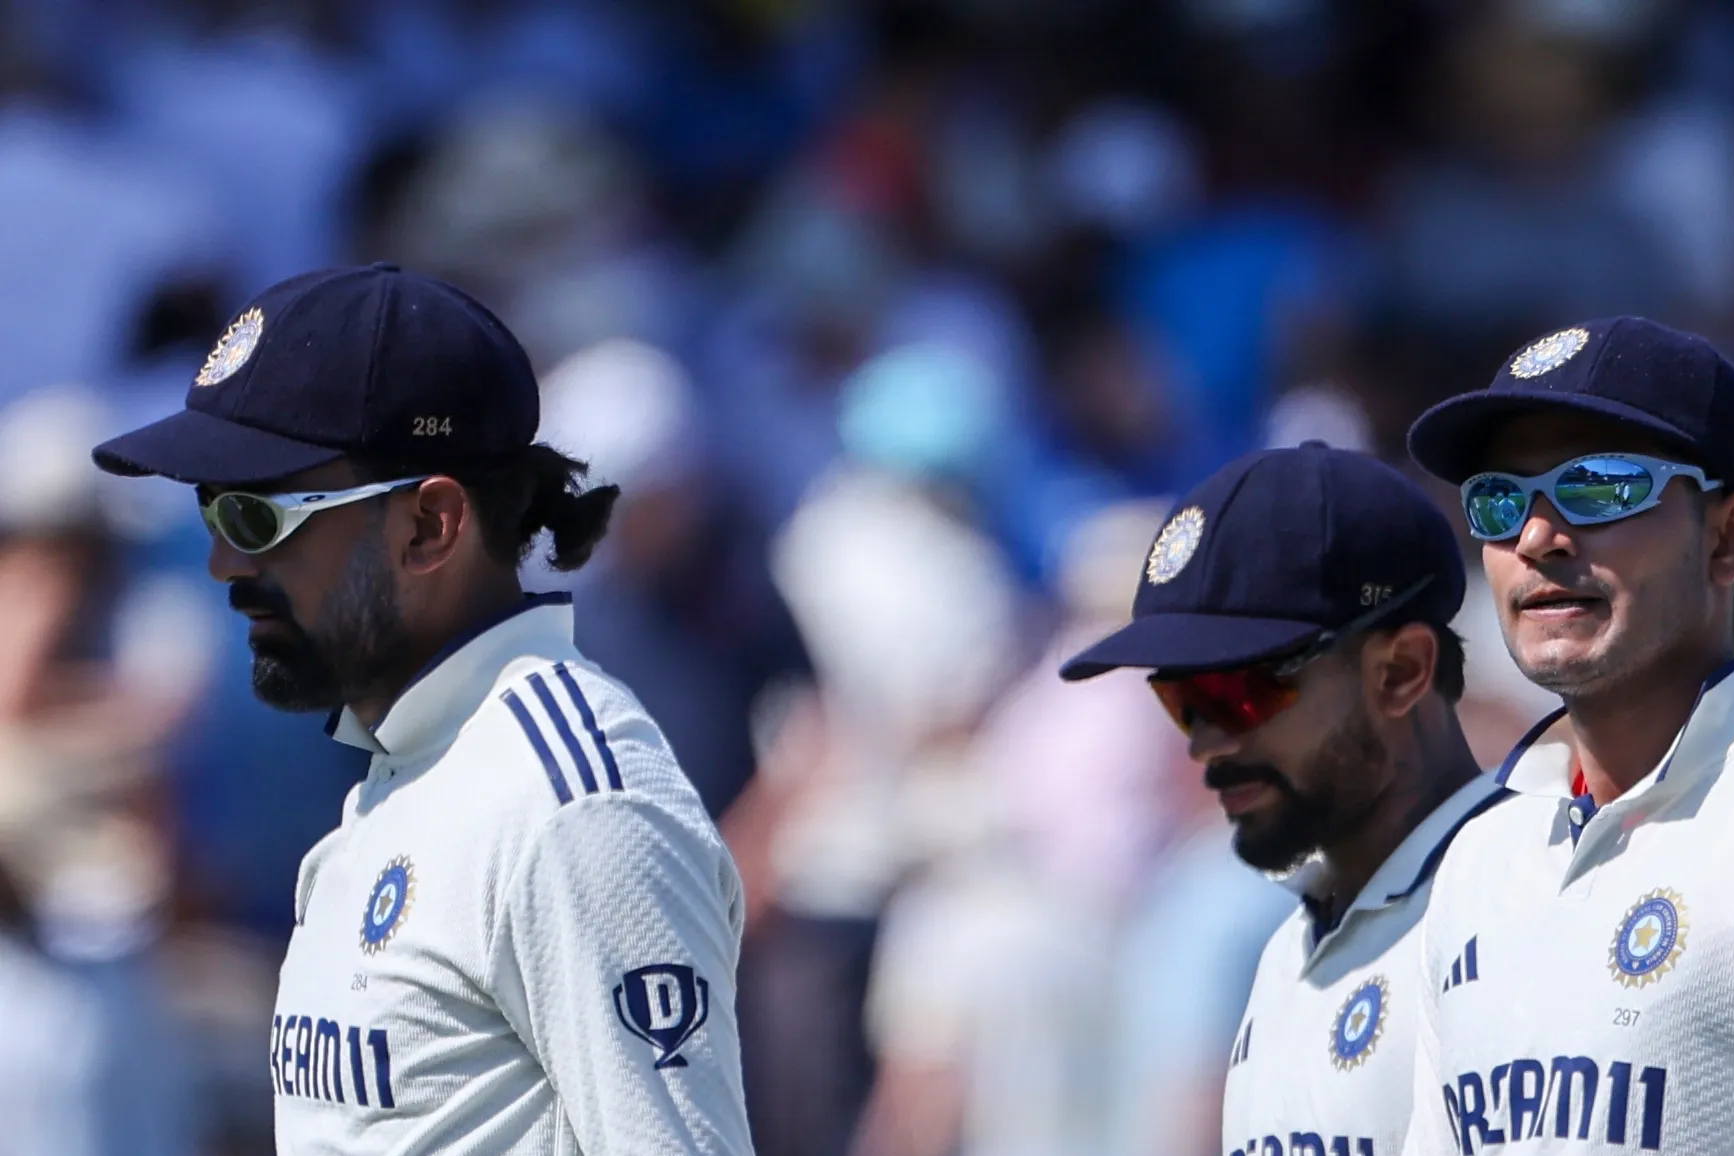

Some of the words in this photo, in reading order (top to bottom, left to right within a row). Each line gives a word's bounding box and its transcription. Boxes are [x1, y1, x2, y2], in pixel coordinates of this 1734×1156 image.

[412, 416, 453, 436] 284
[350, 973, 368, 992] 284
[1613, 1007, 1641, 1027] 297
